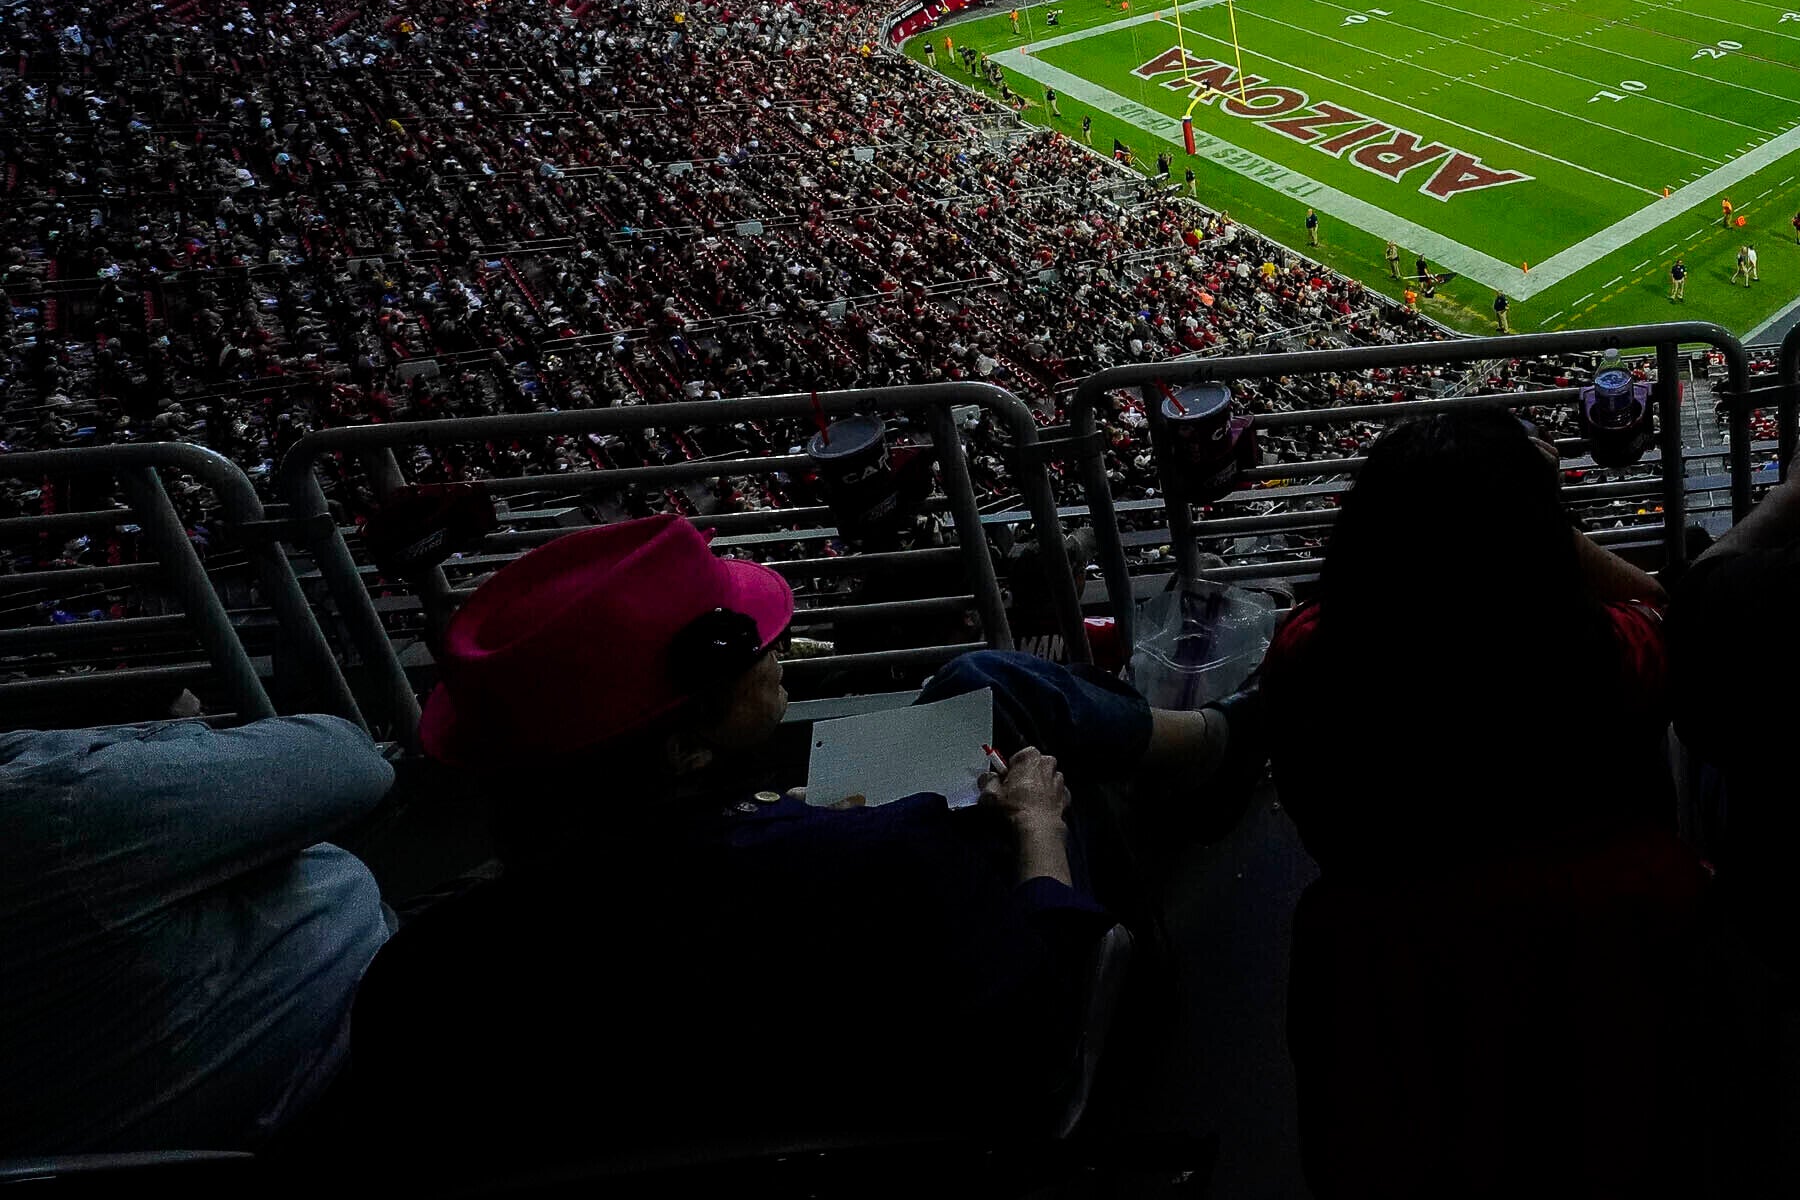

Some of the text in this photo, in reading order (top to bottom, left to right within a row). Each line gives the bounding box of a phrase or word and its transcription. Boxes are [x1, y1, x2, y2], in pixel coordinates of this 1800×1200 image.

[1345, 7, 1393, 24] 10
[1696, 40, 1744, 60] 20
[1594, 79, 1648, 102] 10
[1111, 103, 1149, 121] US
[1129, 45, 1537, 202] ARIZONA
[1142, 117, 1177, 132] OF
[1211, 147, 1290, 185] TAKES
[1284, 181, 1324, 198] IT
